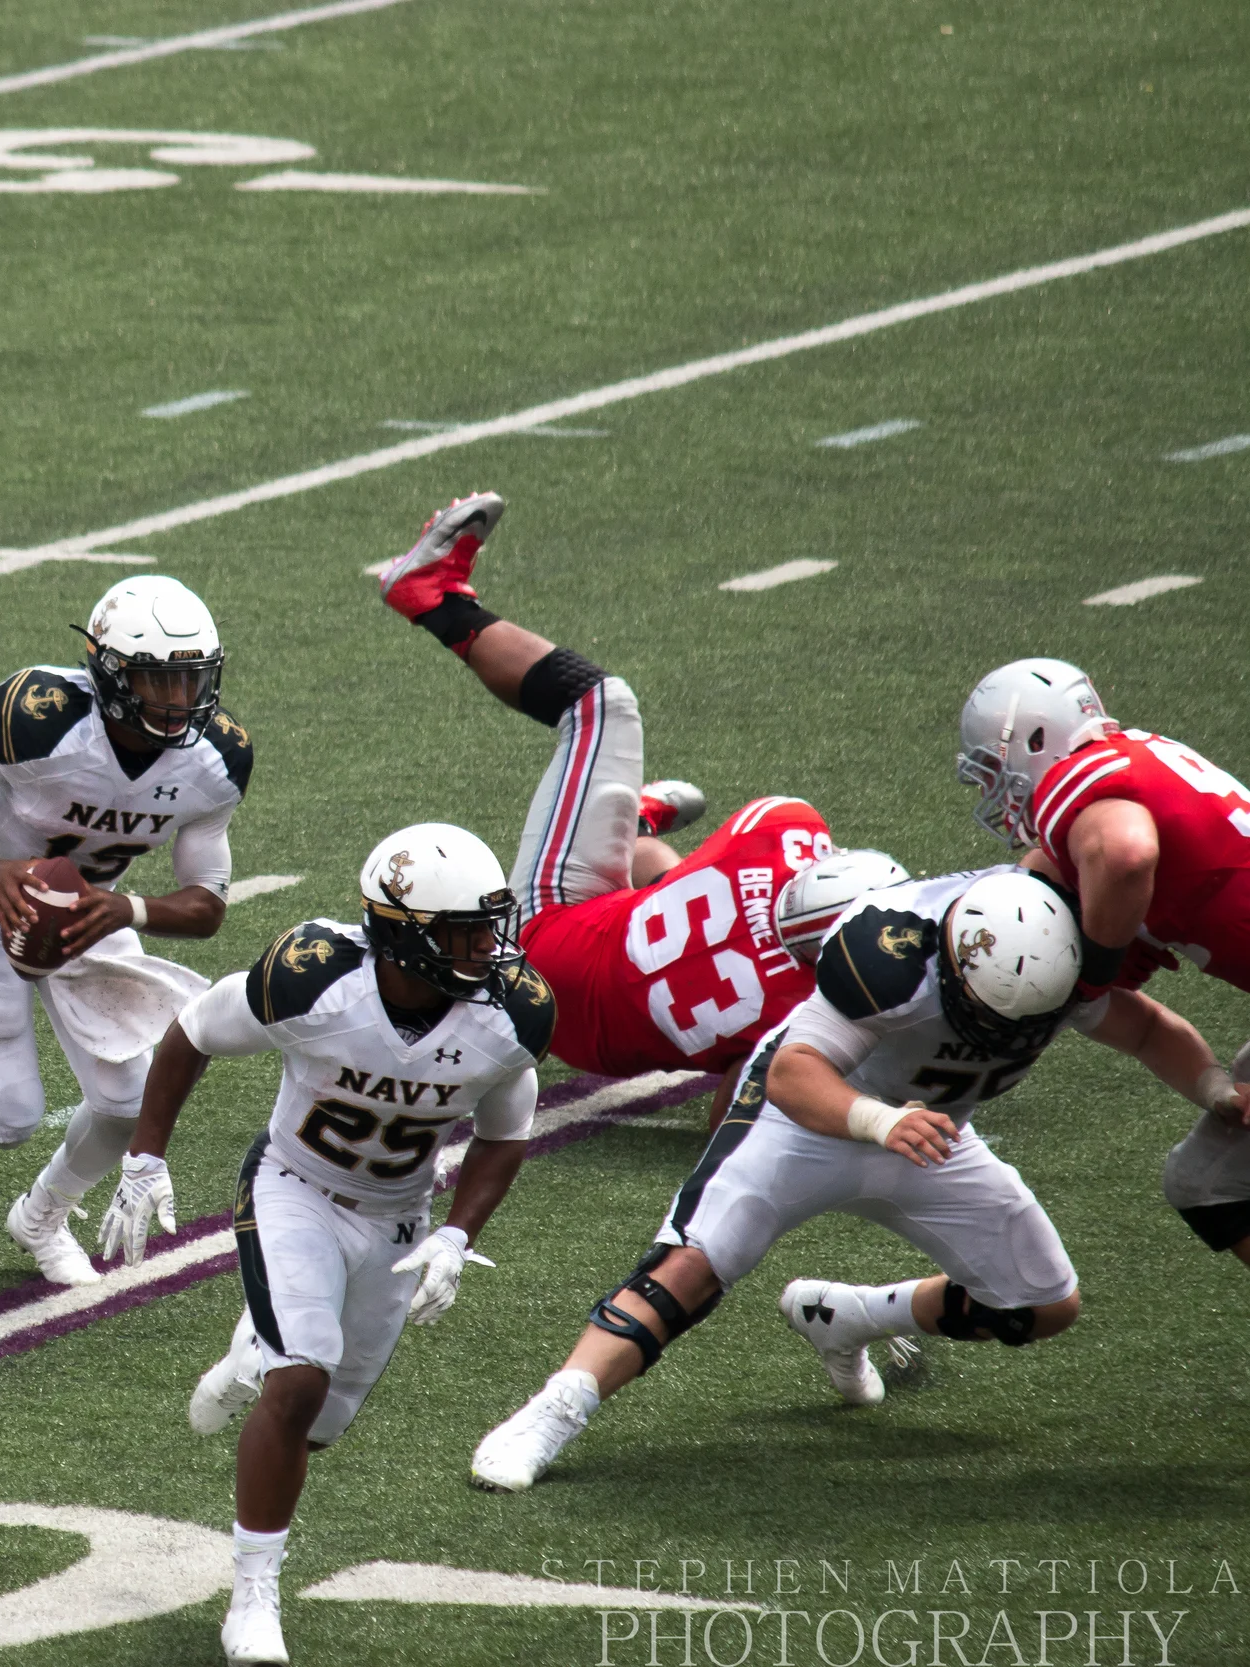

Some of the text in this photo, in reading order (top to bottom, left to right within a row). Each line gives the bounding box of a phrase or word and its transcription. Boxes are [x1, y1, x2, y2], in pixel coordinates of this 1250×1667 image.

[175, 651, 200, 660] NAVY
[62, 801, 175, 835] NAVY
[737, 867, 800, 978] BENNETT
[625, 865, 765, 1057] 63
[335, 1066, 462, 1107] NAVY
[295, 1098, 461, 1180] 25
[393, 1222, 417, 1245] N
